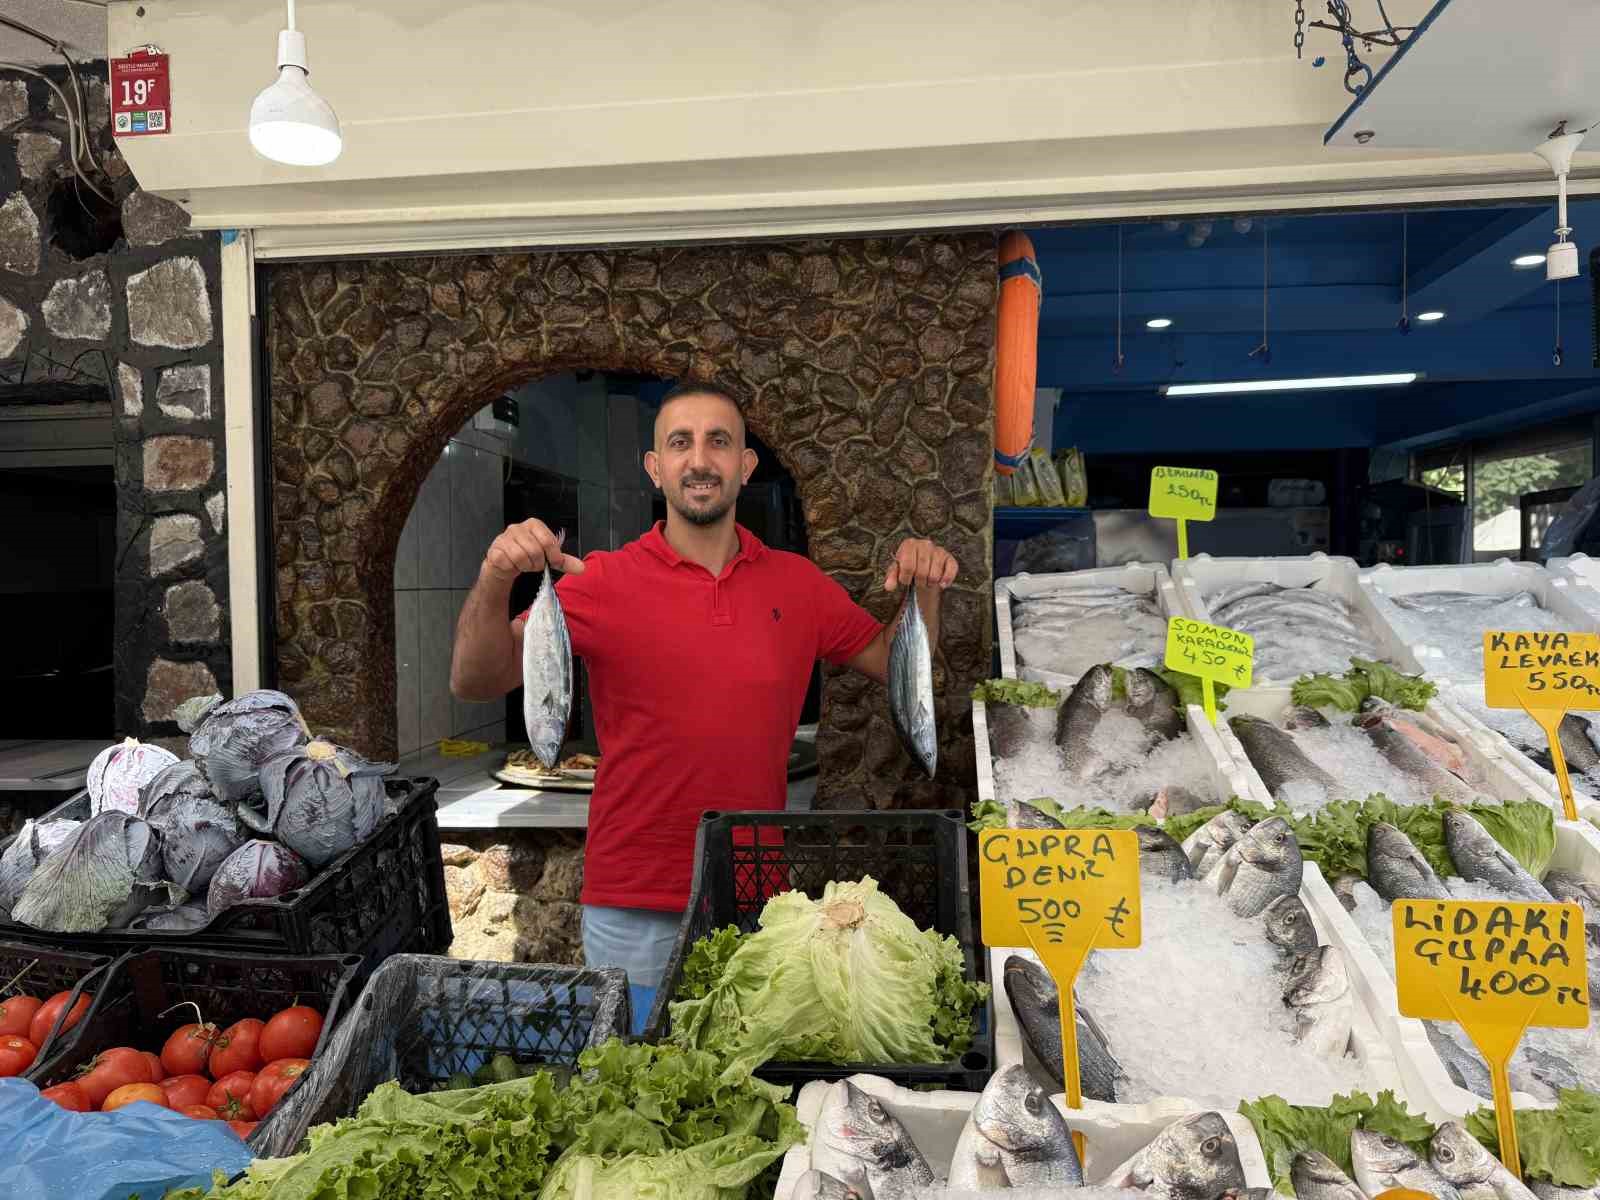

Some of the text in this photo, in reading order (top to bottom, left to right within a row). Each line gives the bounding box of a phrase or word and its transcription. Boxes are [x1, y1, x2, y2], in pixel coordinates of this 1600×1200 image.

[1171, 618, 1246, 645] SOMON
[1491, 632, 1569, 651] KAYA
[1184, 646, 1226, 665] 450
[1500, 651, 1600, 668] LEVREK
[1017, 898, 1081, 923] 500
